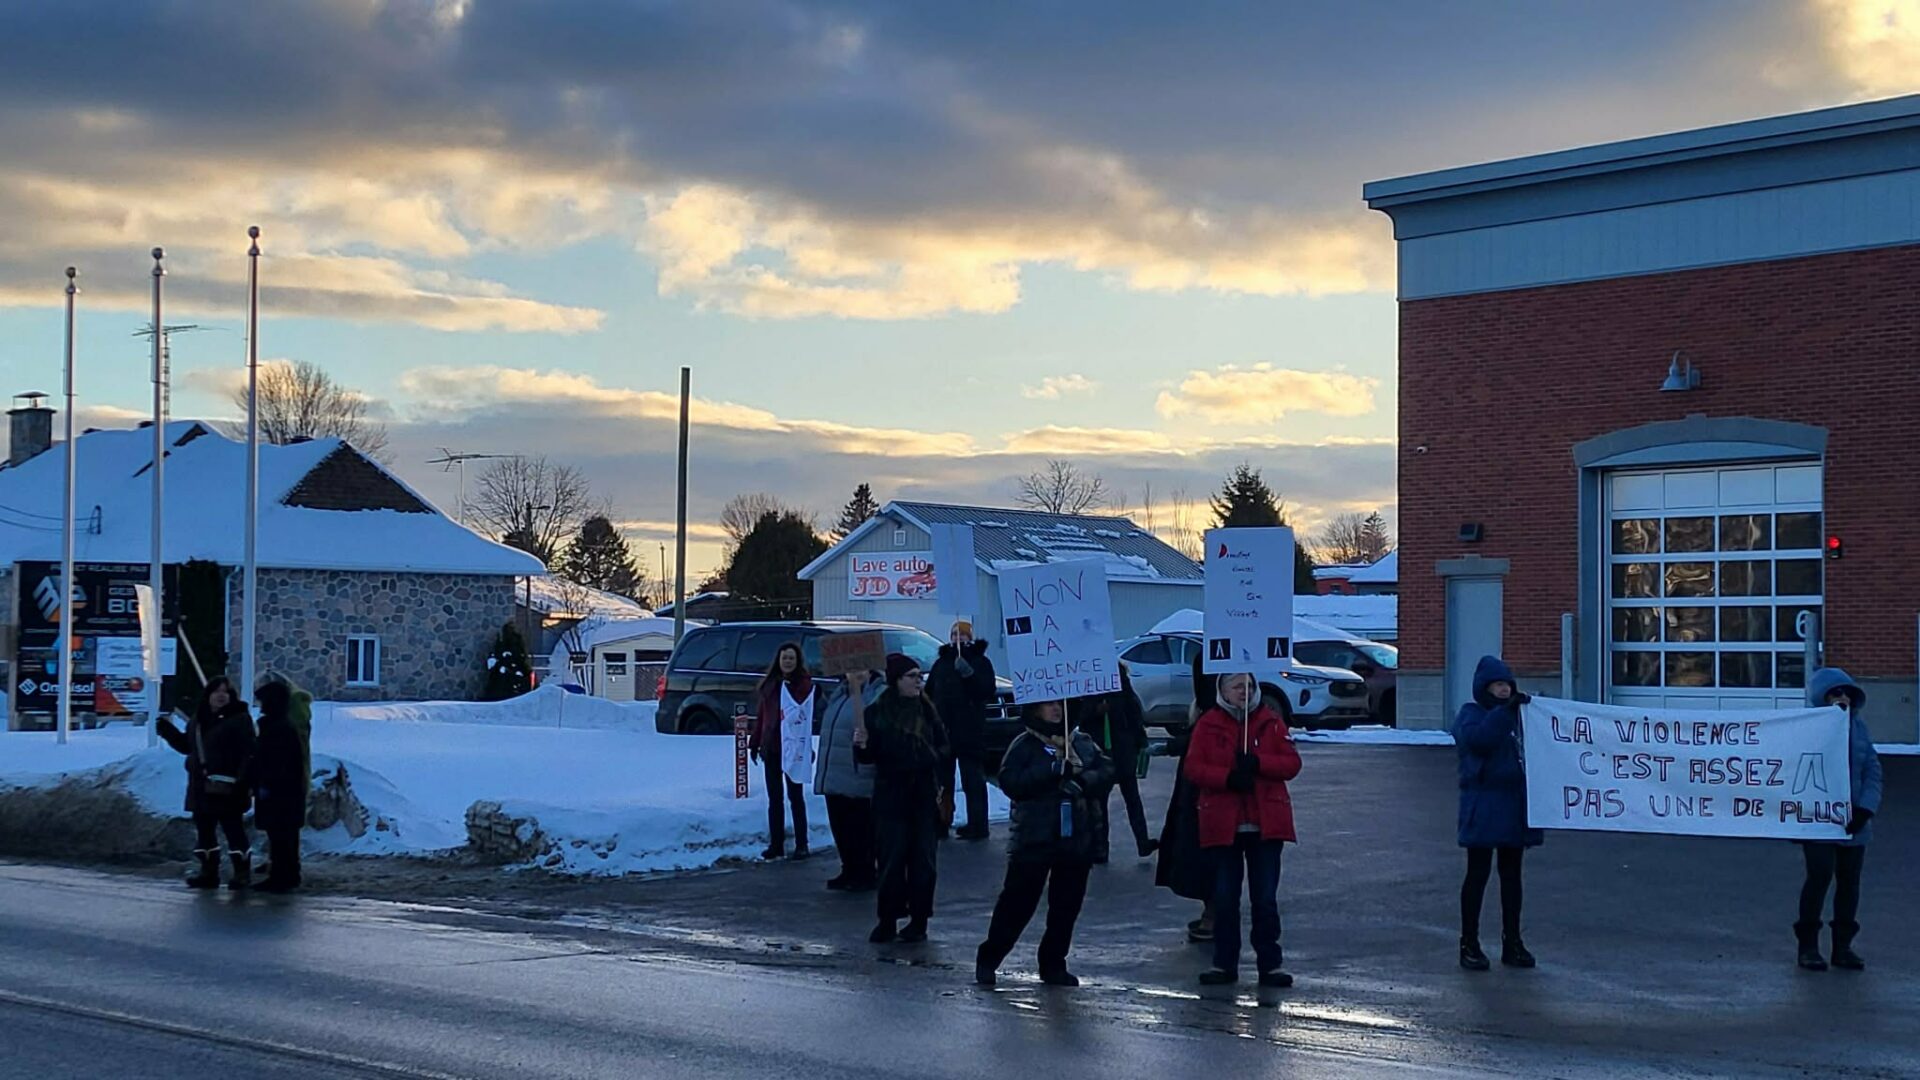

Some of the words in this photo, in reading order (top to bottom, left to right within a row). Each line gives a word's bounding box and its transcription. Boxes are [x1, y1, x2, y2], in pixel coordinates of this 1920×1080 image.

[852, 557, 888, 573] Lave
[894, 555, 927, 572] auto
[851, 576, 891, 597] JD
[1015, 570, 1084, 613] NON
[1043, 614, 1060, 632] A
[1034, 637, 1063, 657] LA
[1552, 715, 1593, 745] LA
[1579, 751, 1675, 782] C'EST
[1689, 756, 1785, 786] ASSEZ
[1563, 786, 1625, 819] PAS
[1649, 795, 1713, 817] UNE
[1733, 797, 1765, 817] DE
